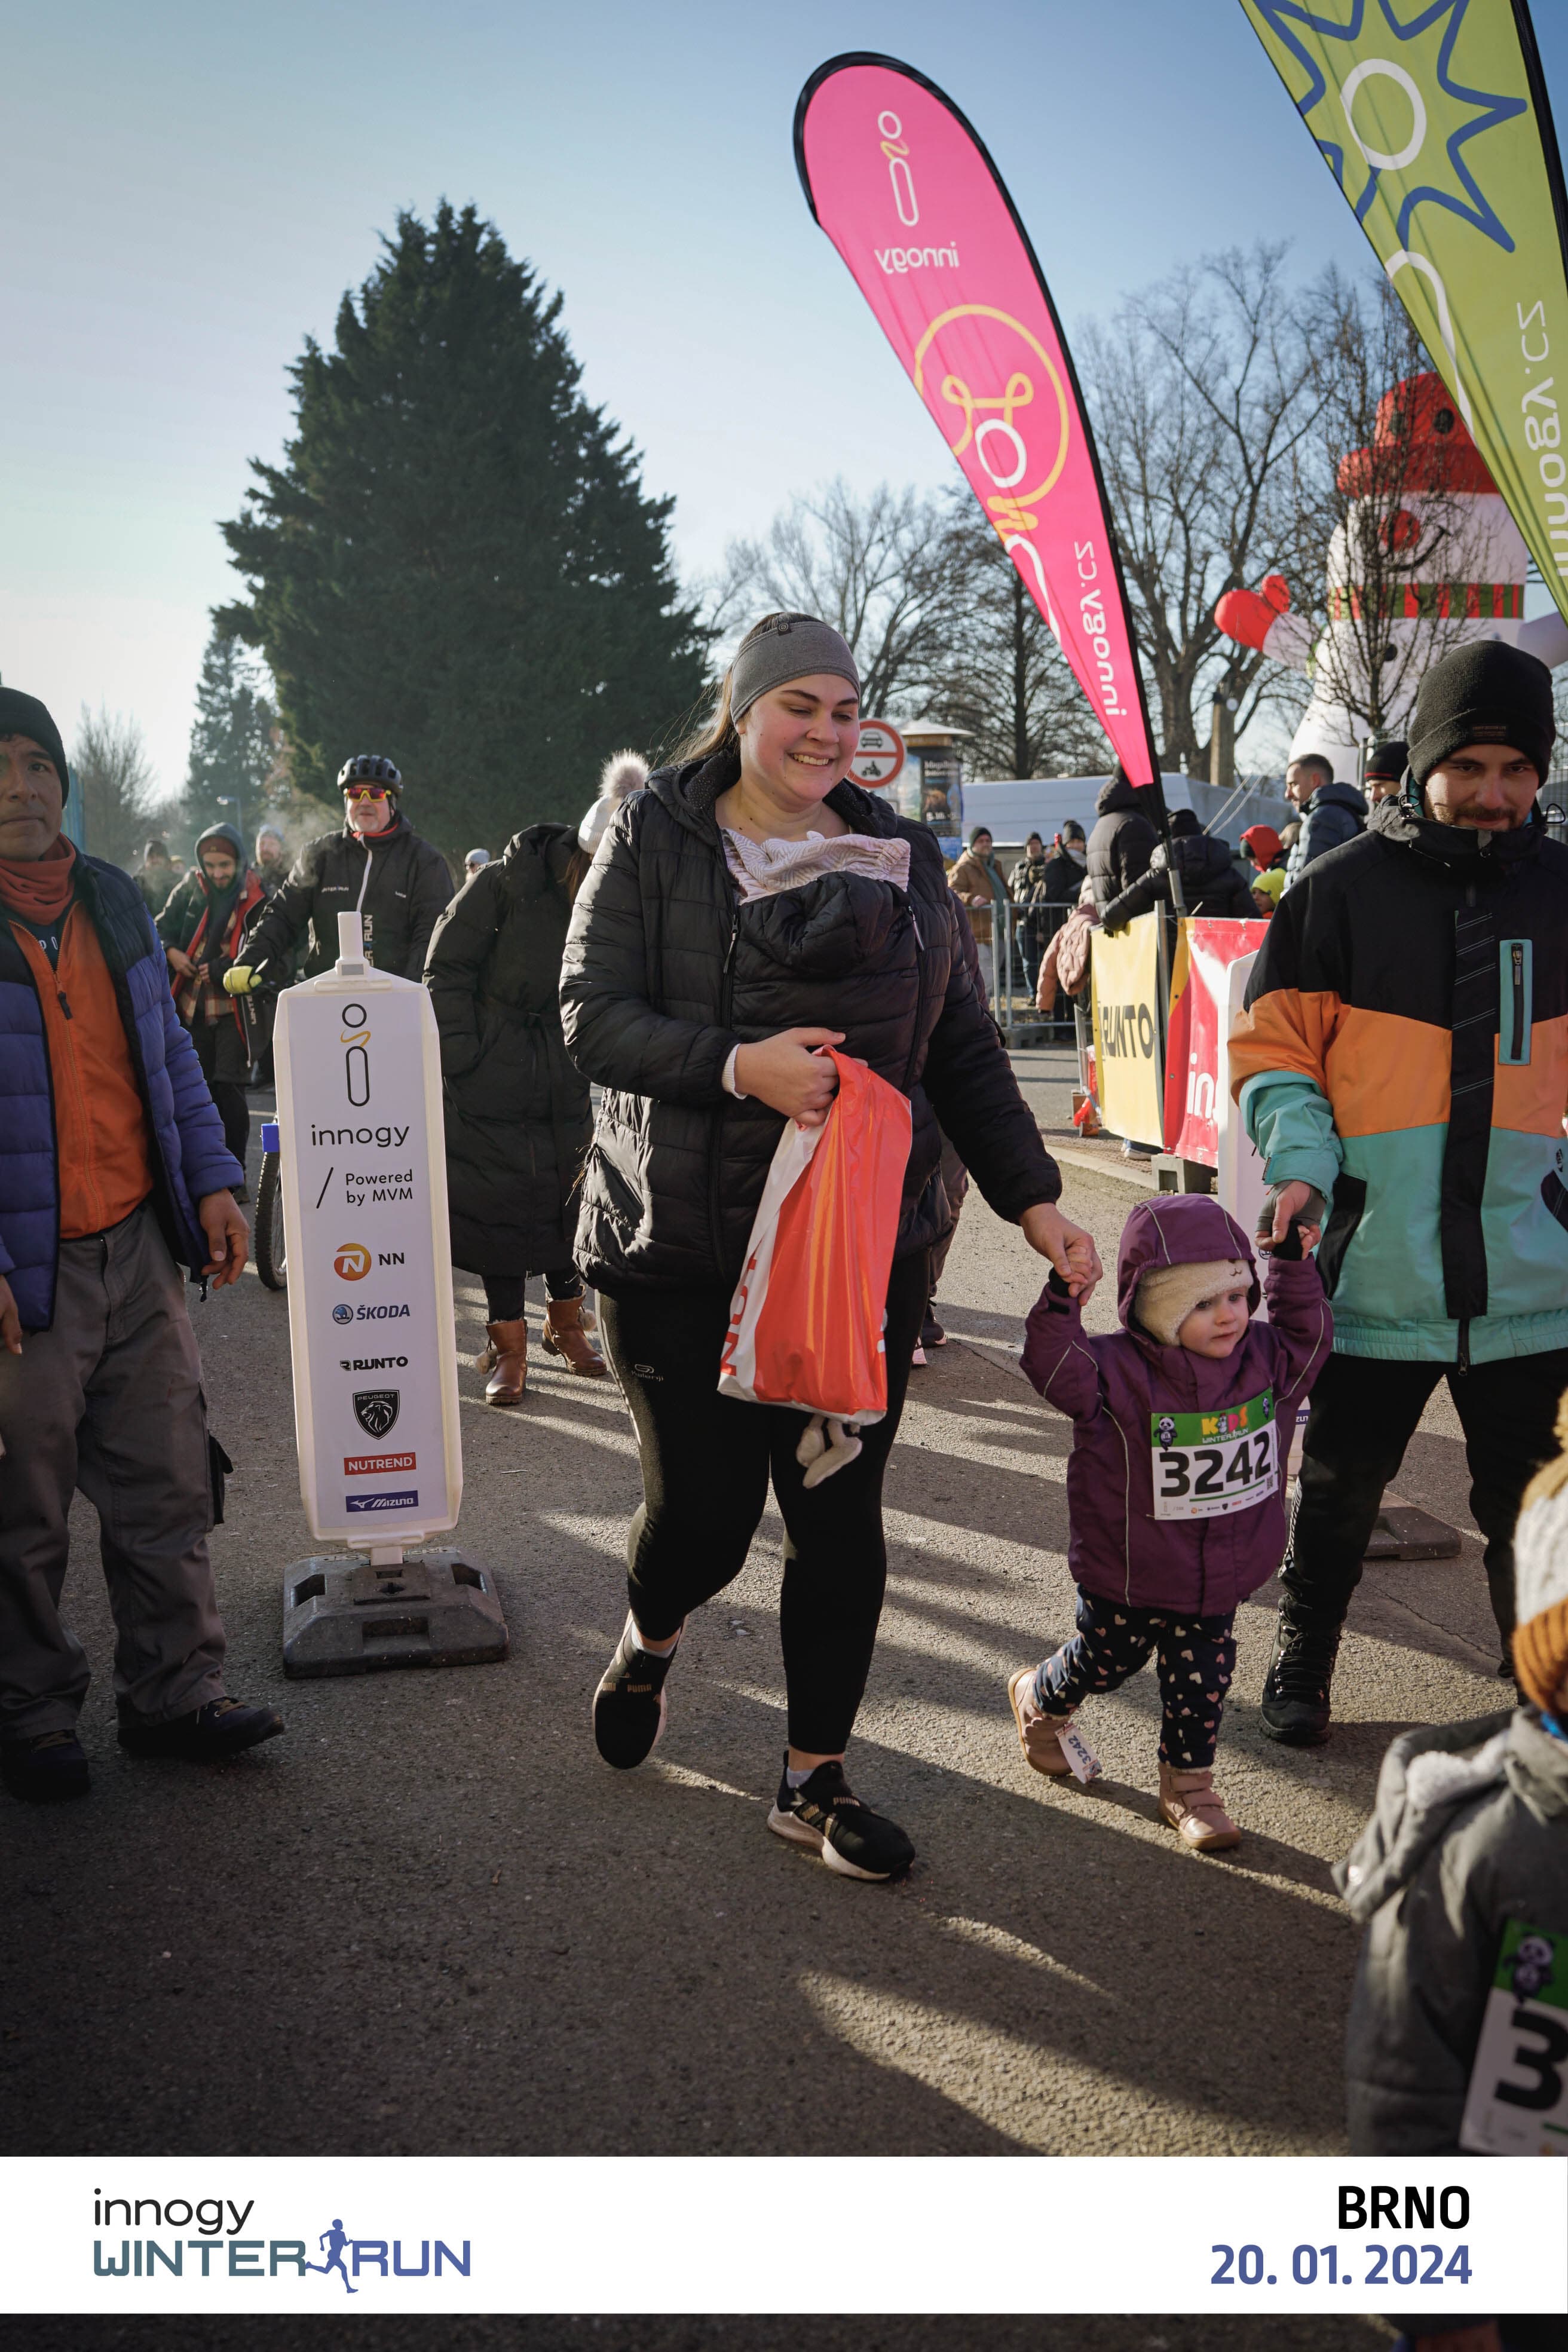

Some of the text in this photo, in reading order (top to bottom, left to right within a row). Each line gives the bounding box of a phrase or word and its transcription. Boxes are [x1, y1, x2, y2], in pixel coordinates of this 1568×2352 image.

[1187, 1052, 1217, 1119] in
[311, 1124, 409, 1147] innogy
[346, 1169, 412, 1186] Powered
[347, 1187, 412, 1206] by MVM
[378, 1252, 405, 1266] NN
[357, 1304, 410, 1321] ŠKODA
[353, 1356, 408, 1370] RUNTO
[1202, 1434, 1231, 1444] WINTER
[348, 1457, 412, 1471] NUTREND
[1159, 1431, 1271, 1497] 3242
[1068, 1735, 1091, 1765] 3242
